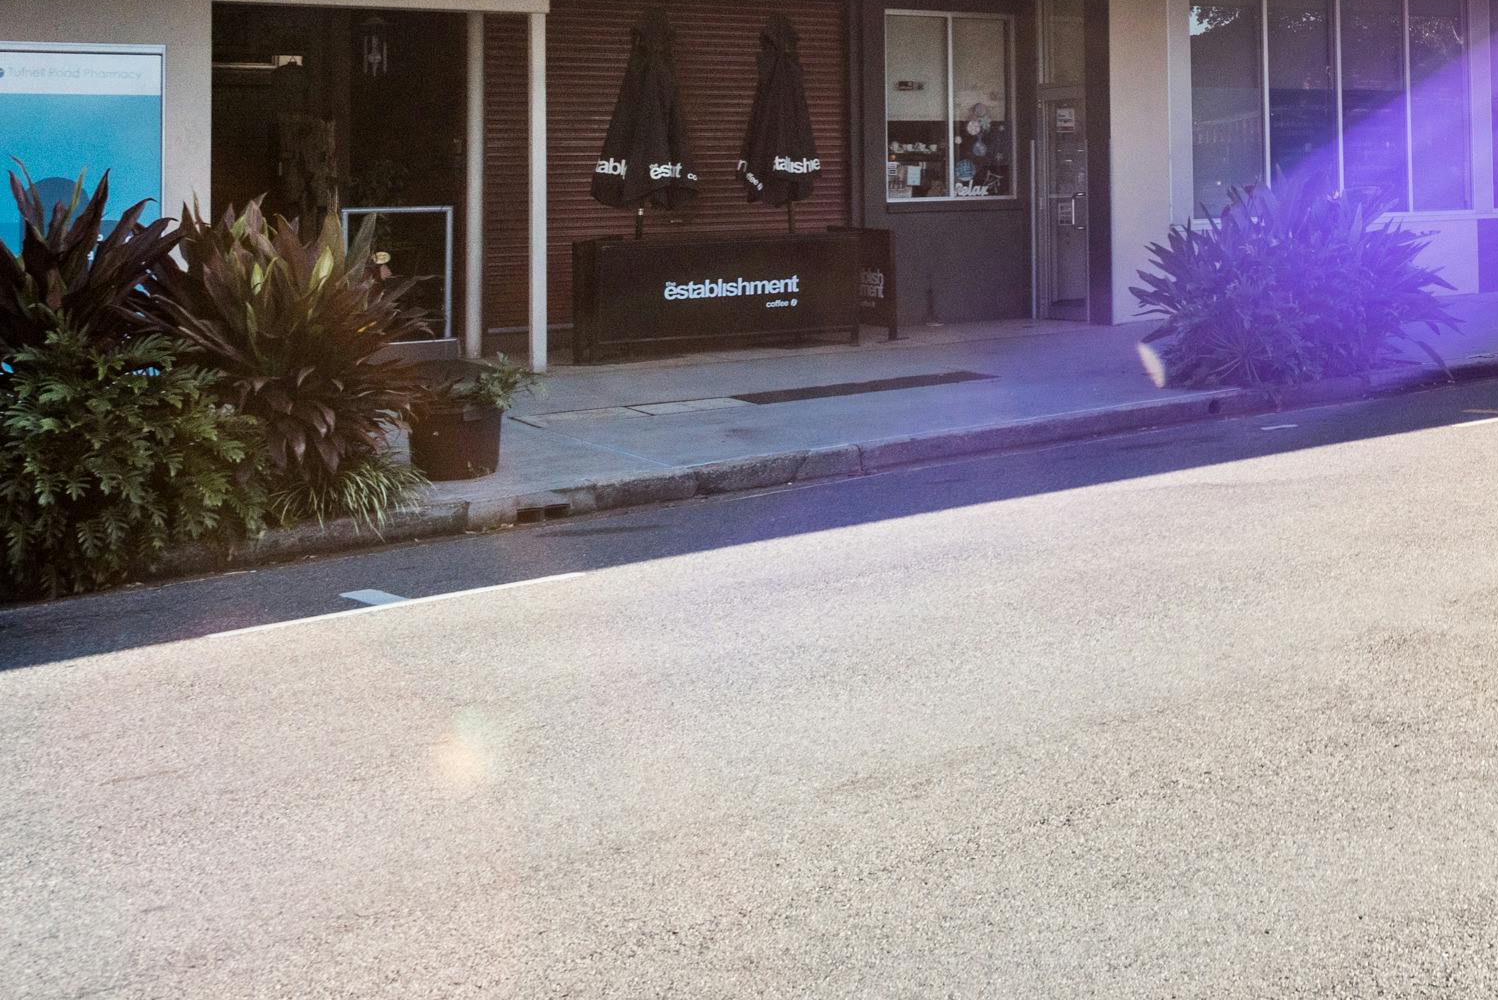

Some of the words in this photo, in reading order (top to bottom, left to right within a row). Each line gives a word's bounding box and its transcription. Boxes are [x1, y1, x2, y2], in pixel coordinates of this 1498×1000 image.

[49, 67, 81, 79] Road
[82, 67, 143, 81] Pharmacy
[954, 179, 989, 197] Relax
[664, 274, 800, 300] establishment
[766, 299, 789, 308] coffee
